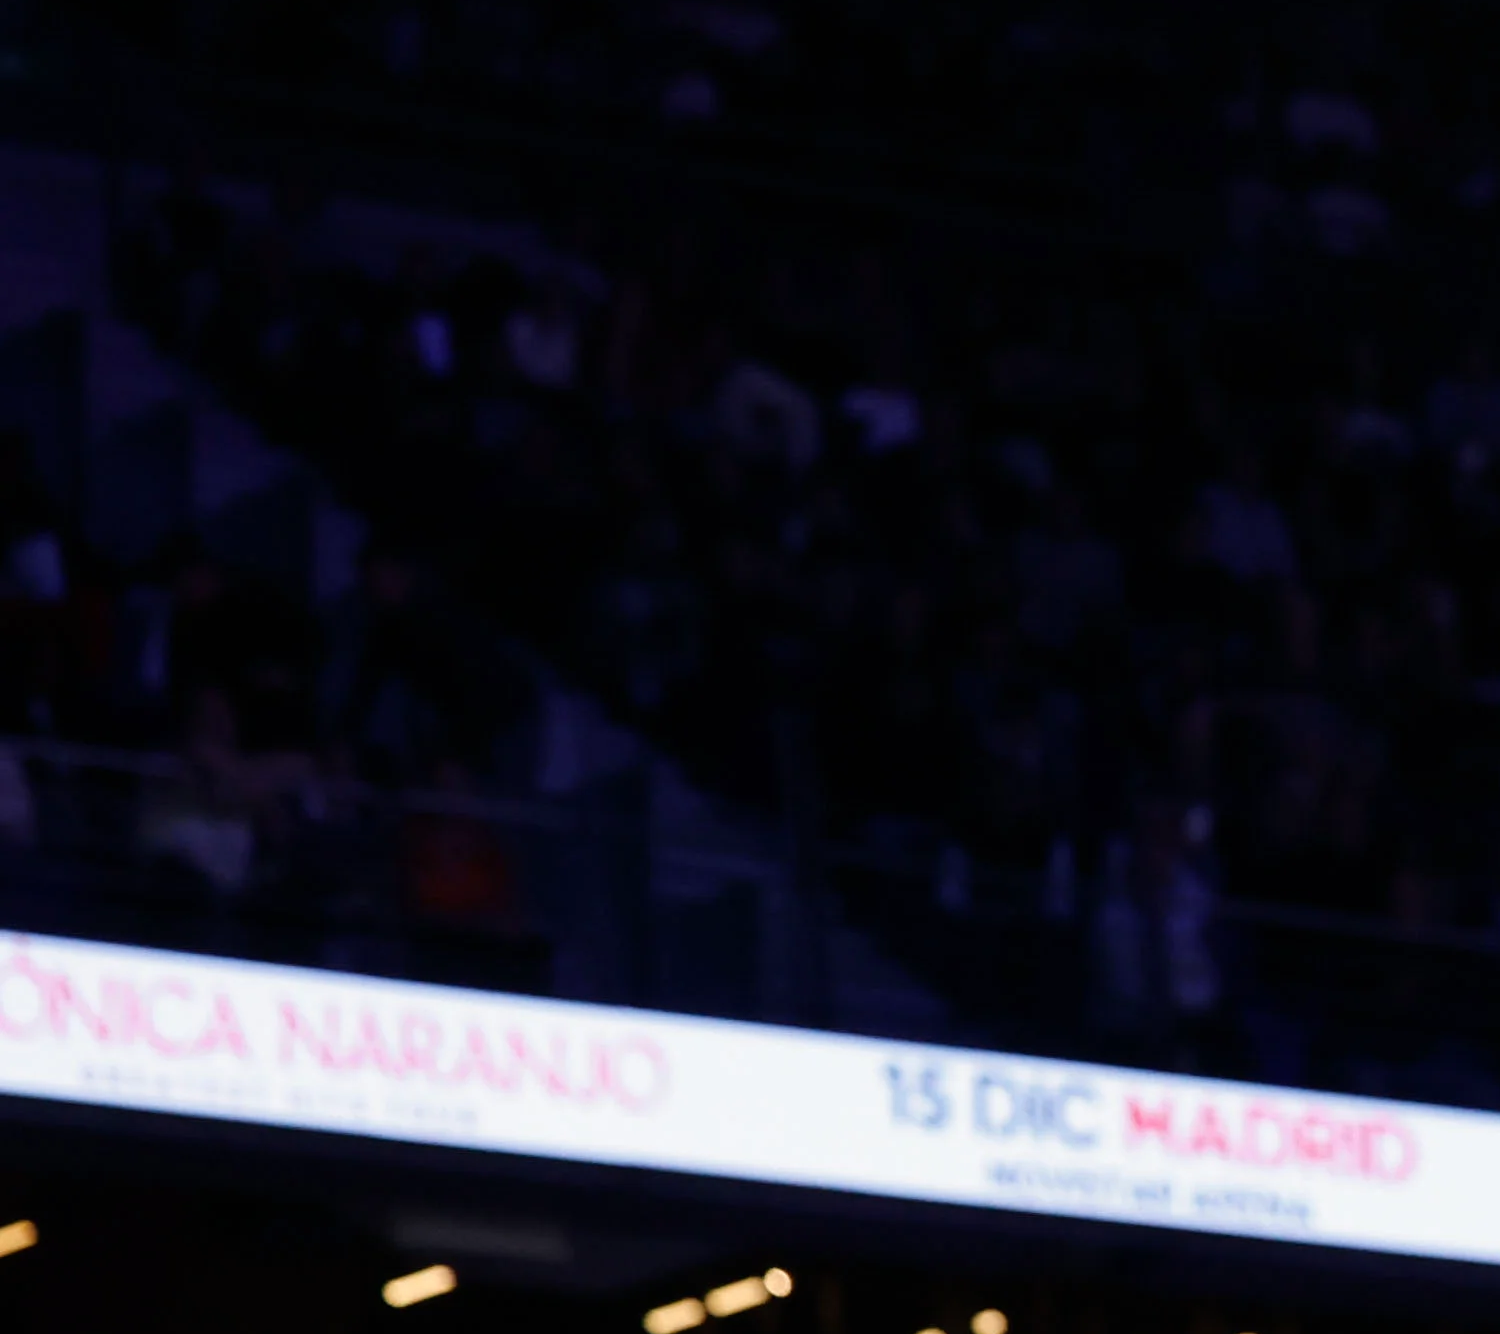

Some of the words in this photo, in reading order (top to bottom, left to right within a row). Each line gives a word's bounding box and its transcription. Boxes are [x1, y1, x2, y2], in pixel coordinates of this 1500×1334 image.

[0, 934, 248, 1060] ÓNICA
[277, 1000, 672, 1113] NARANJO
[883, 1063, 950, 1129] 15
[973, 1072, 1099, 1145] DIC
[1125, 1094, 1423, 1183] MADRID
